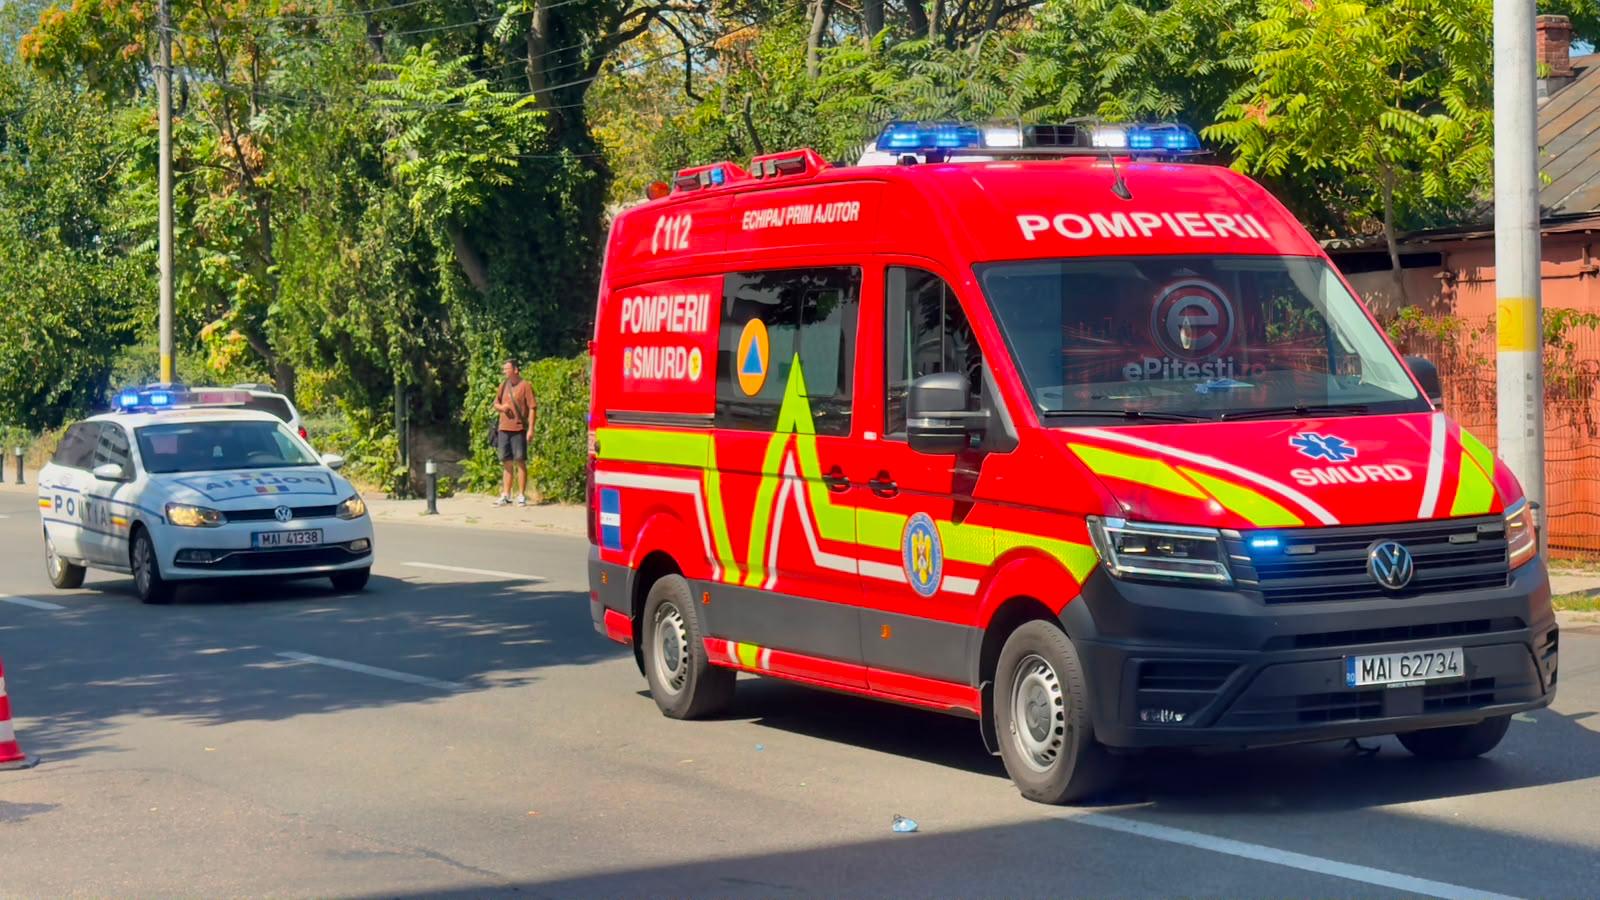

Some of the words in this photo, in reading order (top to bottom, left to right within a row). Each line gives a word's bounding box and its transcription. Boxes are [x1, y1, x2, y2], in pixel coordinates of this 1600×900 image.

[742, 207, 786, 230] ECHIPAJ
[785, 204, 814, 226] PRIM
[813, 201, 860, 224] AJUTOR
[1016, 212, 1271, 241] POMPIERII
[663, 214, 692, 250] 112
[620, 294, 710, 333] POMPIERII
[633, 346, 687, 380] SMURD
[1290, 464, 1413, 487] SMURD
[262, 532, 281, 545] MAI
[286, 531, 318, 544] 41338
[1361, 657, 1391, 682] MAI
[1400, 651, 1457, 677] 62734
